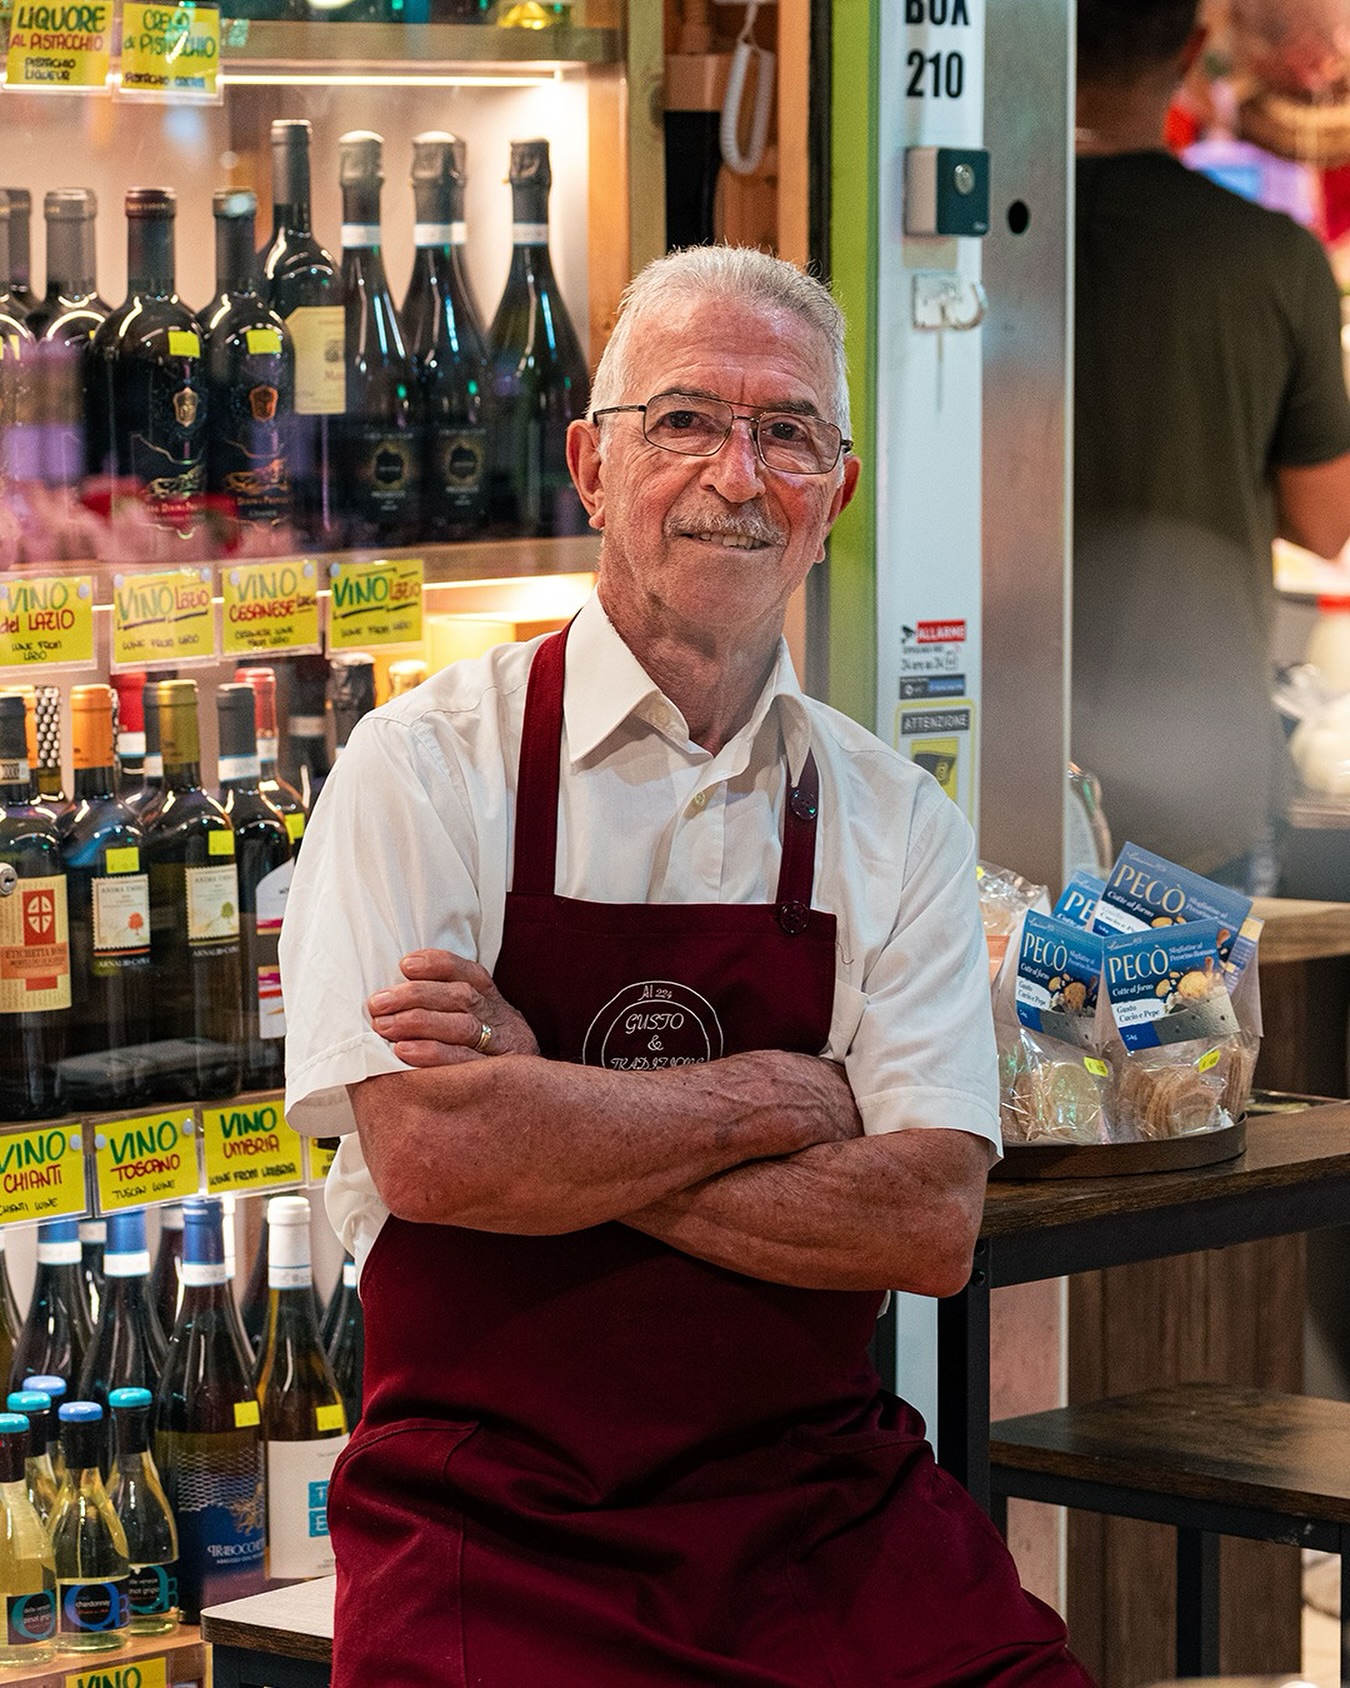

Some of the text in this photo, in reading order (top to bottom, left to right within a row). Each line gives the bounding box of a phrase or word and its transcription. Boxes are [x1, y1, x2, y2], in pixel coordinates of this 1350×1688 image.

[17, 6, 105, 33] LIQUORE
[9, 33, 104, 51] AL PISTACCHIO
[25, 57, 76, 69] PISTACHIO
[906, 49, 963, 98] 210
[25, 69, 70, 80] LIQUEUR
[237, 567, 297, 602] VINO
[333, 576, 388, 607] VINO
[8, 582, 69, 612] VINO
[118, 586, 173, 620] VINO
[28, 609, 75, 630] LAZIO
[229, 599, 295, 622] CESANESE
[918, 626, 965, 640] ALLARME
[37, 640, 62, 649] FROM
[904, 714, 968, 731] ATTENZIONE
[1113, 864, 1186, 913] PECÒ
[1023, 932, 1068, 971] PECÒ
[1109, 945, 1169, 983] PECÒ
[656, 988, 672, 999] 224
[1112, 983, 1154, 997] Cotte al forno
[1116, 1003, 1136, 1013] Gusto
[1119, 1013, 1139, 1022] Cacio
[1144, 1009, 1159, 1018] Pepe
[625, 1013, 684, 1034] GUSTO
[647, 1034, 664, 1051] &
[220, 1107, 277, 1138] VINO
[0, 1131, 66, 1174] VINO
[109, 1121, 177, 1164] VINO
[223, 1134, 279, 1159] UMBRIA
[110, 1154, 180, 1181] TOSCANO
[233, 1168, 258, 1183] FROM
[262, 1162, 296, 1177] UMBRIA
[3, 1164, 62, 1193] CHIANTI
[112, 1180, 175, 1199] TUSCAN WINE
[35, 1198, 57, 1210] WINE
[76, 1600, 110, 1608] chardonnay
